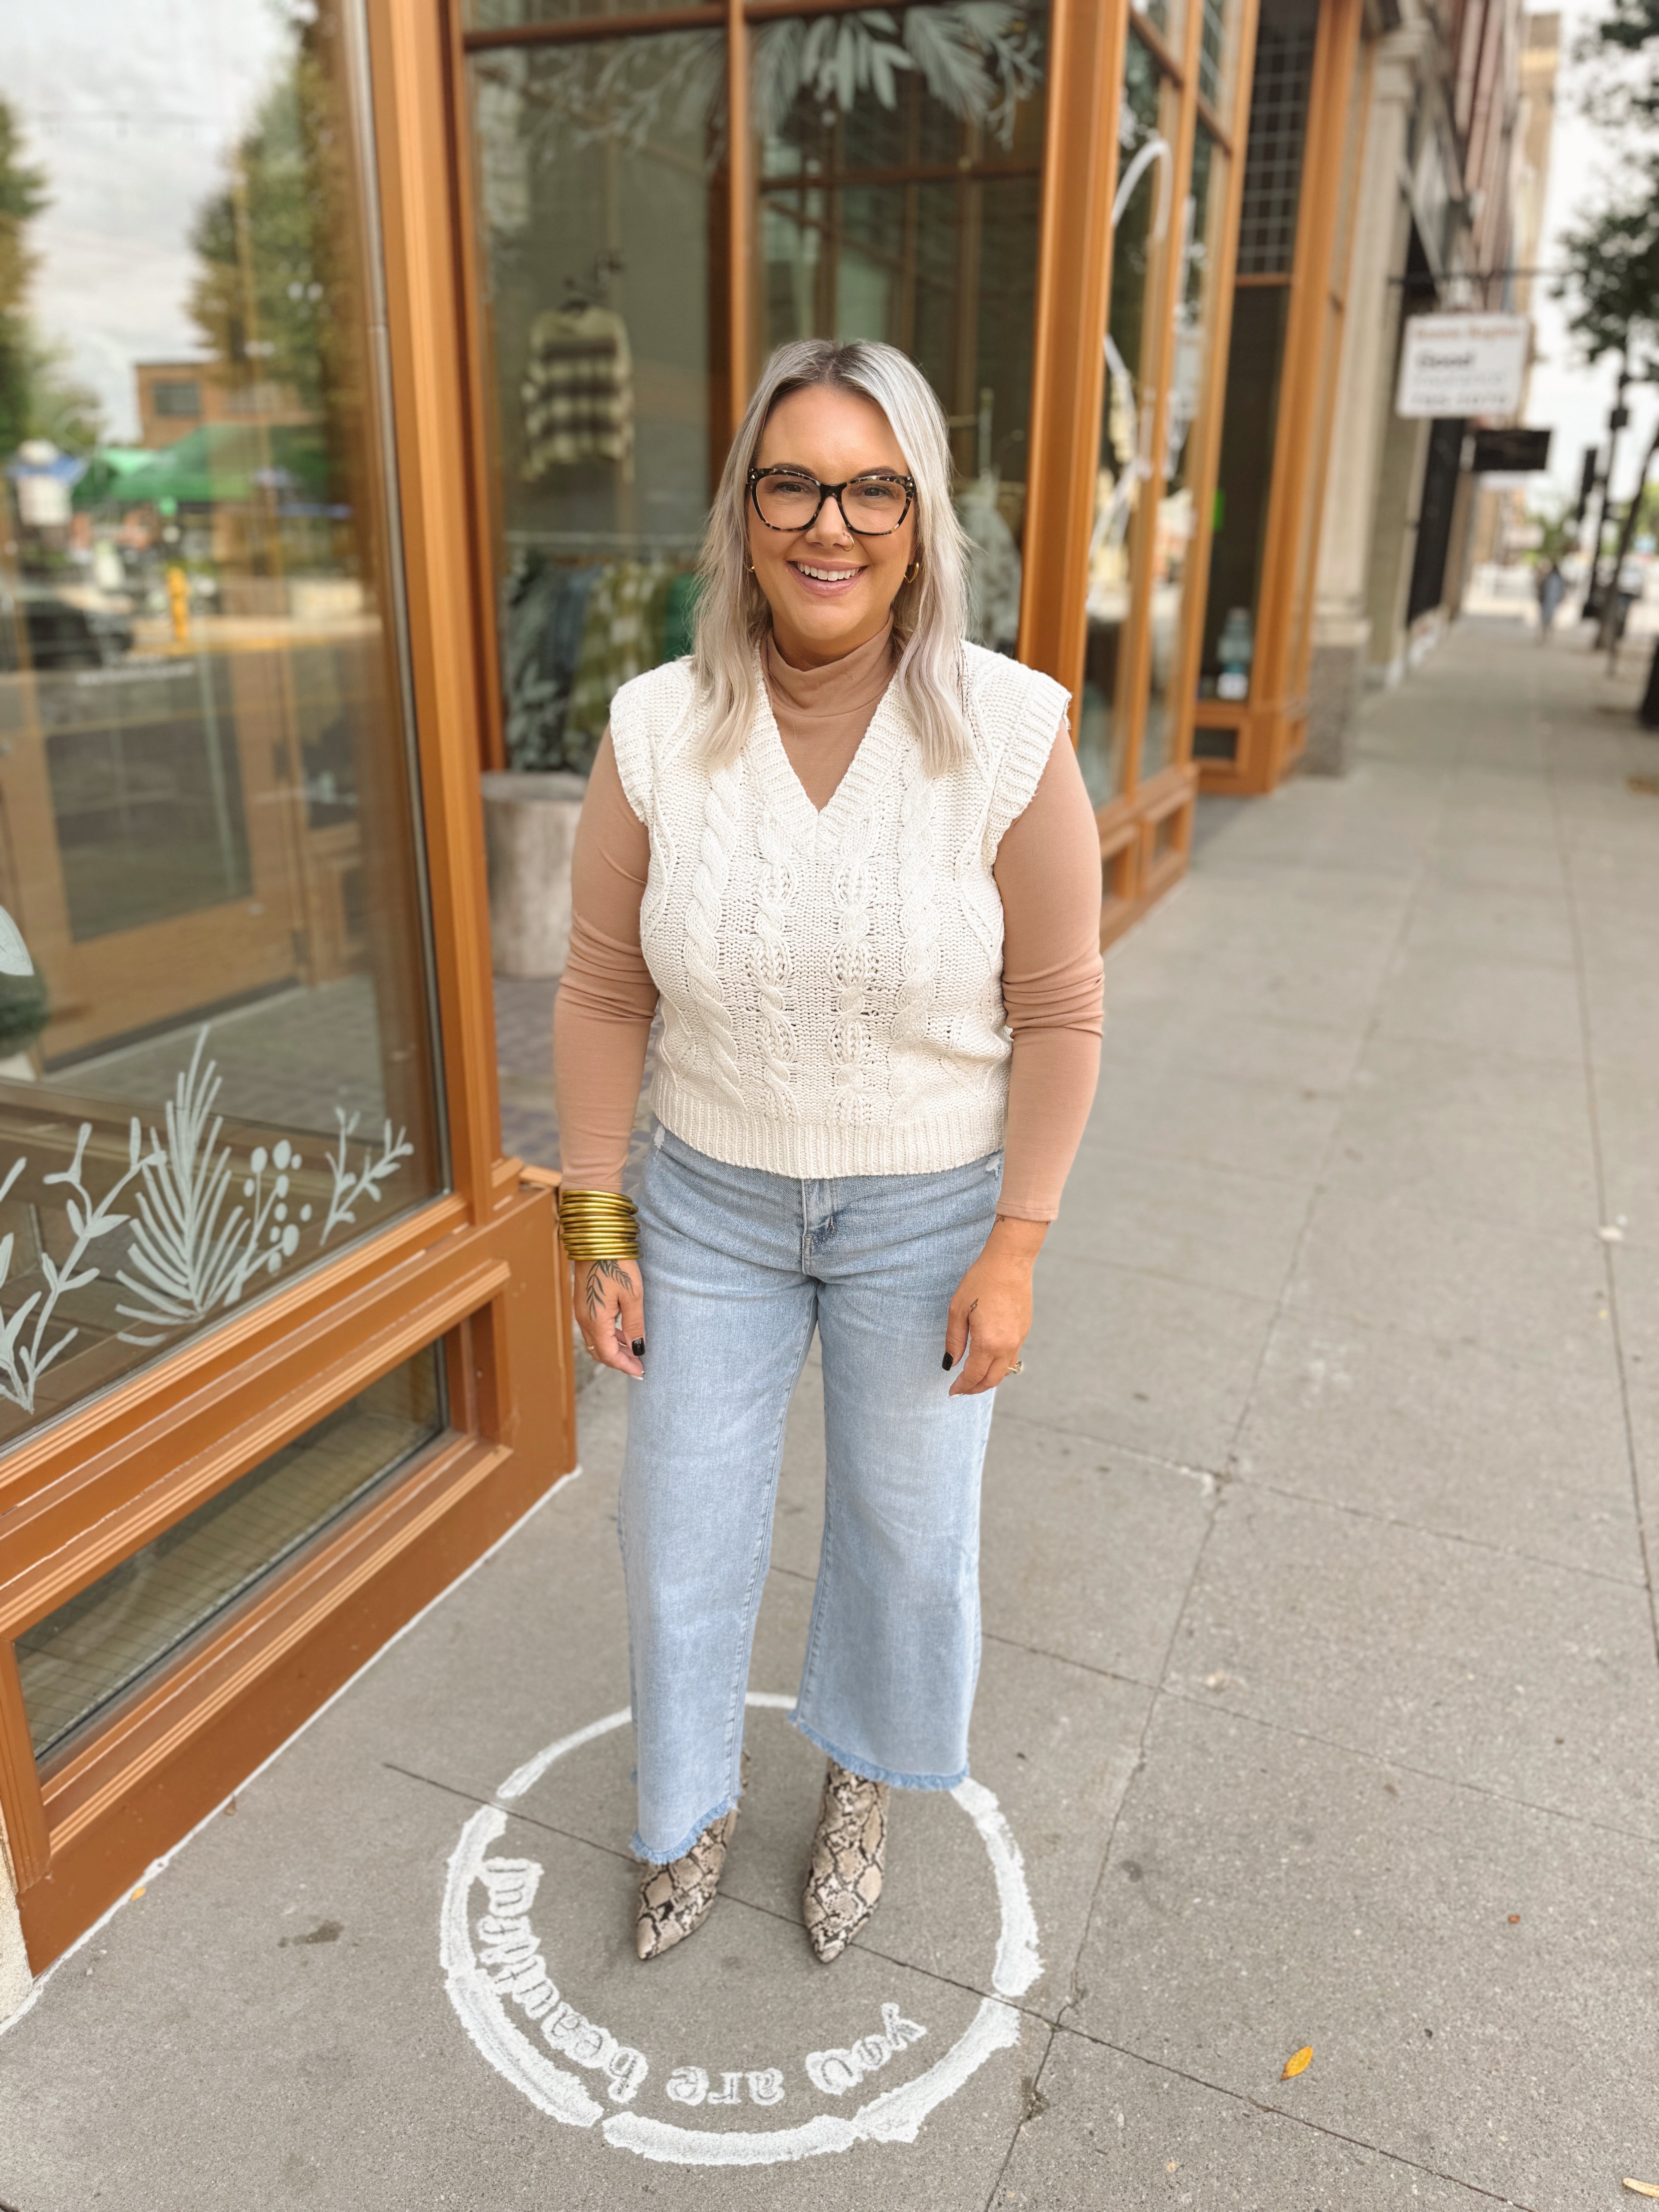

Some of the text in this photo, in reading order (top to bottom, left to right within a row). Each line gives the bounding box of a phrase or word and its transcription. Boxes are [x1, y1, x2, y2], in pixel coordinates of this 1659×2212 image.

[476, 1857, 926, 2106] you are beautiful
